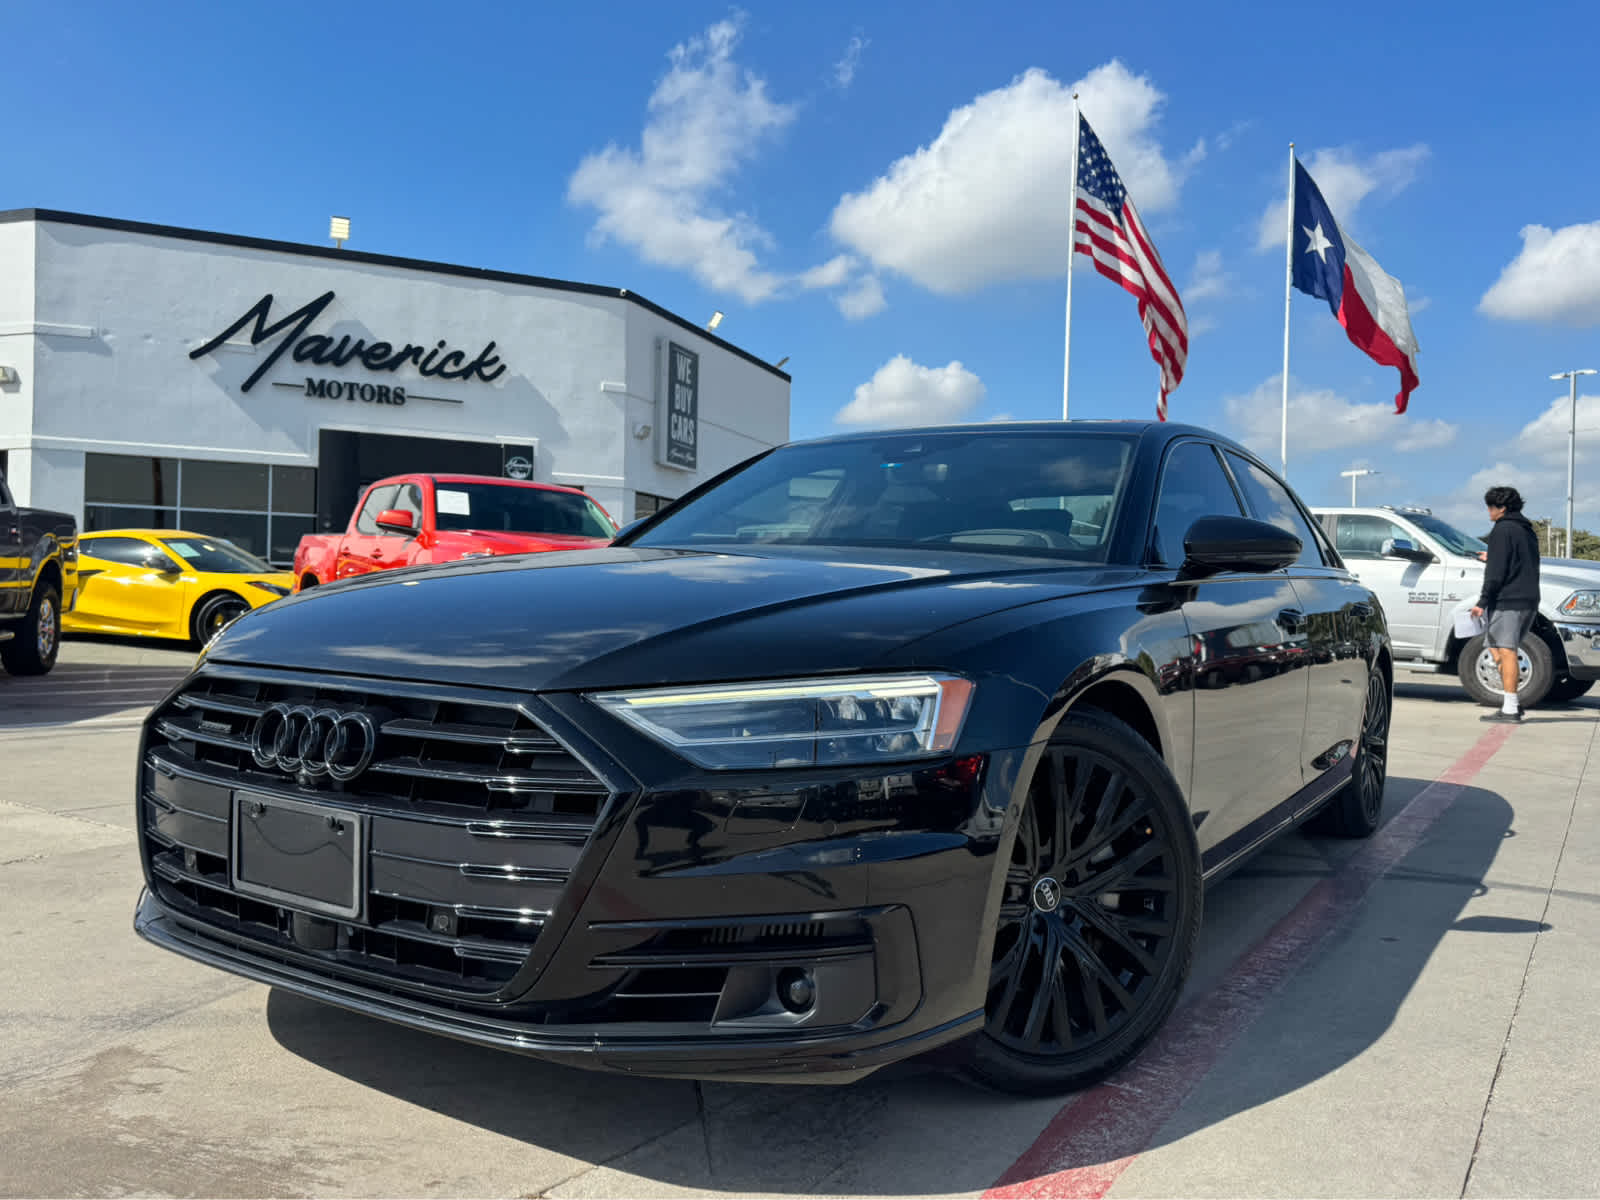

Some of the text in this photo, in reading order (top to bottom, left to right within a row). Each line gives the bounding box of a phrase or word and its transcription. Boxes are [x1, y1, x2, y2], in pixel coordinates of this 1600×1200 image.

[189, 290, 507, 393] Maverick
[676, 351, 692, 385] WE
[304, 377, 407, 406] MOTORS
[674, 383, 694, 415] BUY
[671, 412, 695, 446] CARS
